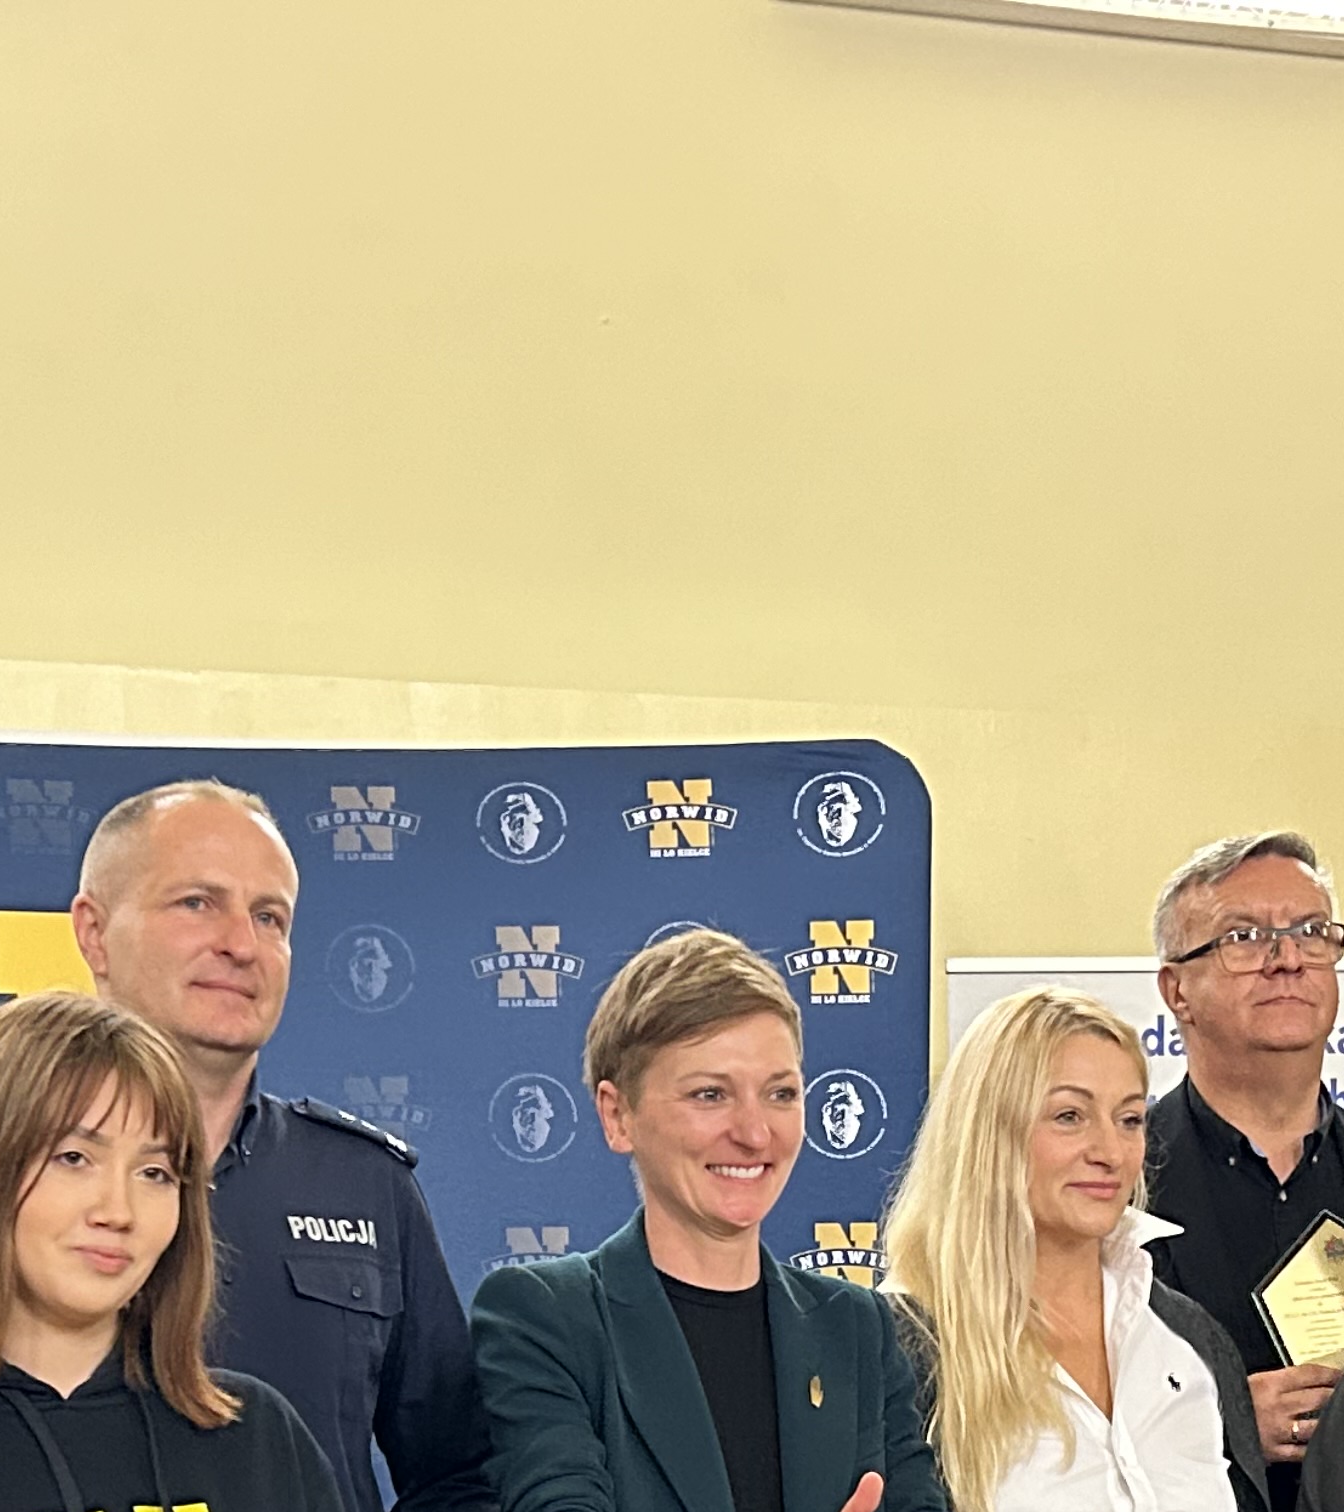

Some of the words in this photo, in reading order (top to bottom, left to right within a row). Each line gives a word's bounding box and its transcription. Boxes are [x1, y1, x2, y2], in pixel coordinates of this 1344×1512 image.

[314, 811, 412, 829] NORWID
[630, 805, 729, 825] NORWID
[480, 953, 576, 973] NORWID
[793, 949, 889, 969] NORWID
